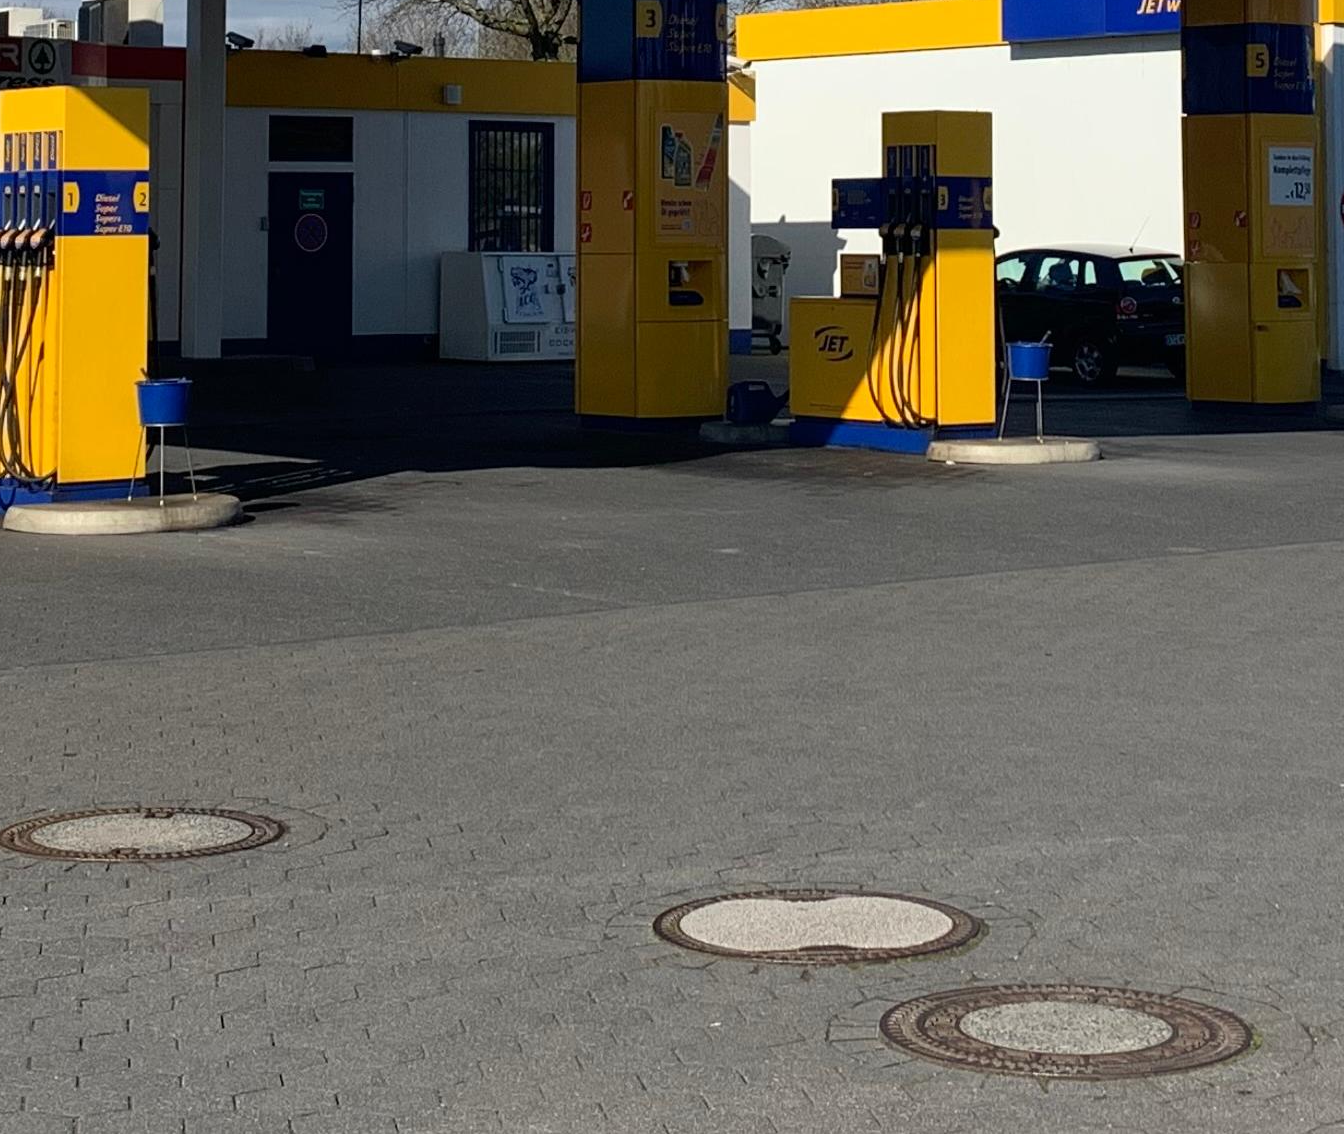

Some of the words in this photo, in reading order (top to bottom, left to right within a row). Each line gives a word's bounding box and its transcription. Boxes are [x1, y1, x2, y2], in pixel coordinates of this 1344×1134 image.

[646, 9, 656, 28] 3
[1255, 52, 1265, 69] 5
[67, 192, 74, 207] 1
[95, 193, 121, 203] Diesel
[139, 192, 147, 207] 2
[94, 204, 119, 214] Super
[94, 224, 118, 234] Super
[819, 334, 849, 352] JET
